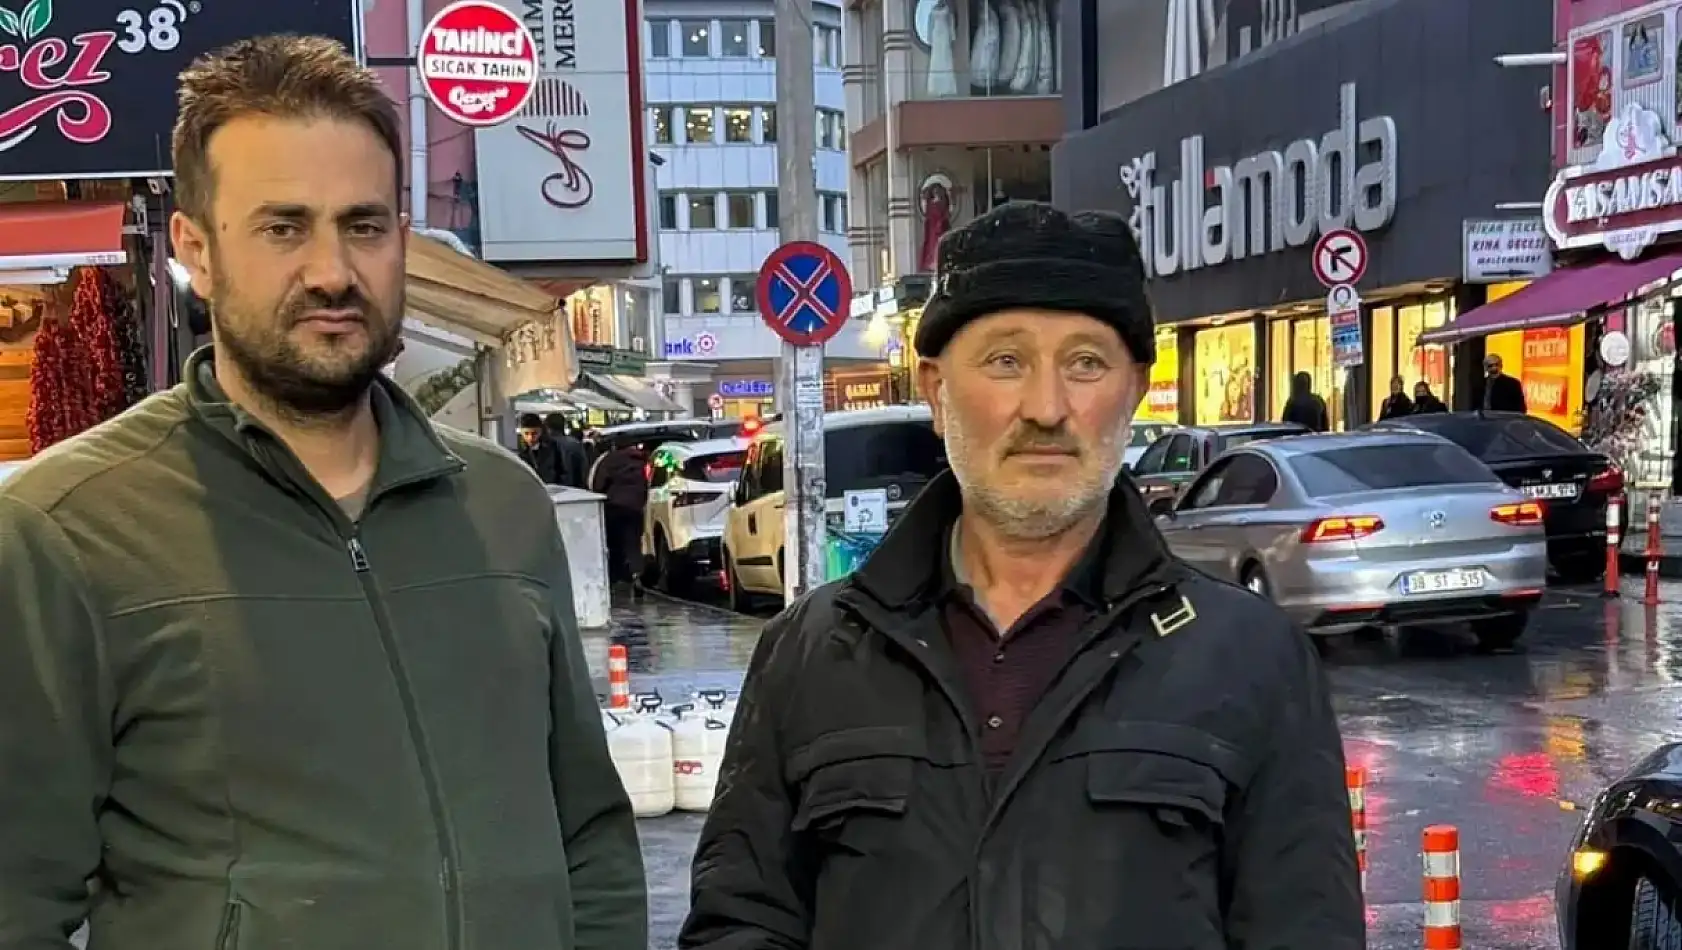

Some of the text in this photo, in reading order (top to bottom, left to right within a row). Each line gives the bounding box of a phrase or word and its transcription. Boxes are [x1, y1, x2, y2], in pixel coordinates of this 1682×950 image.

[116, 8, 180, 52] 38
[553, 0, 576, 68] MER
[431, 59, 477, 74] SICAK
[1138, 82, 1397, 279] fullamoda
